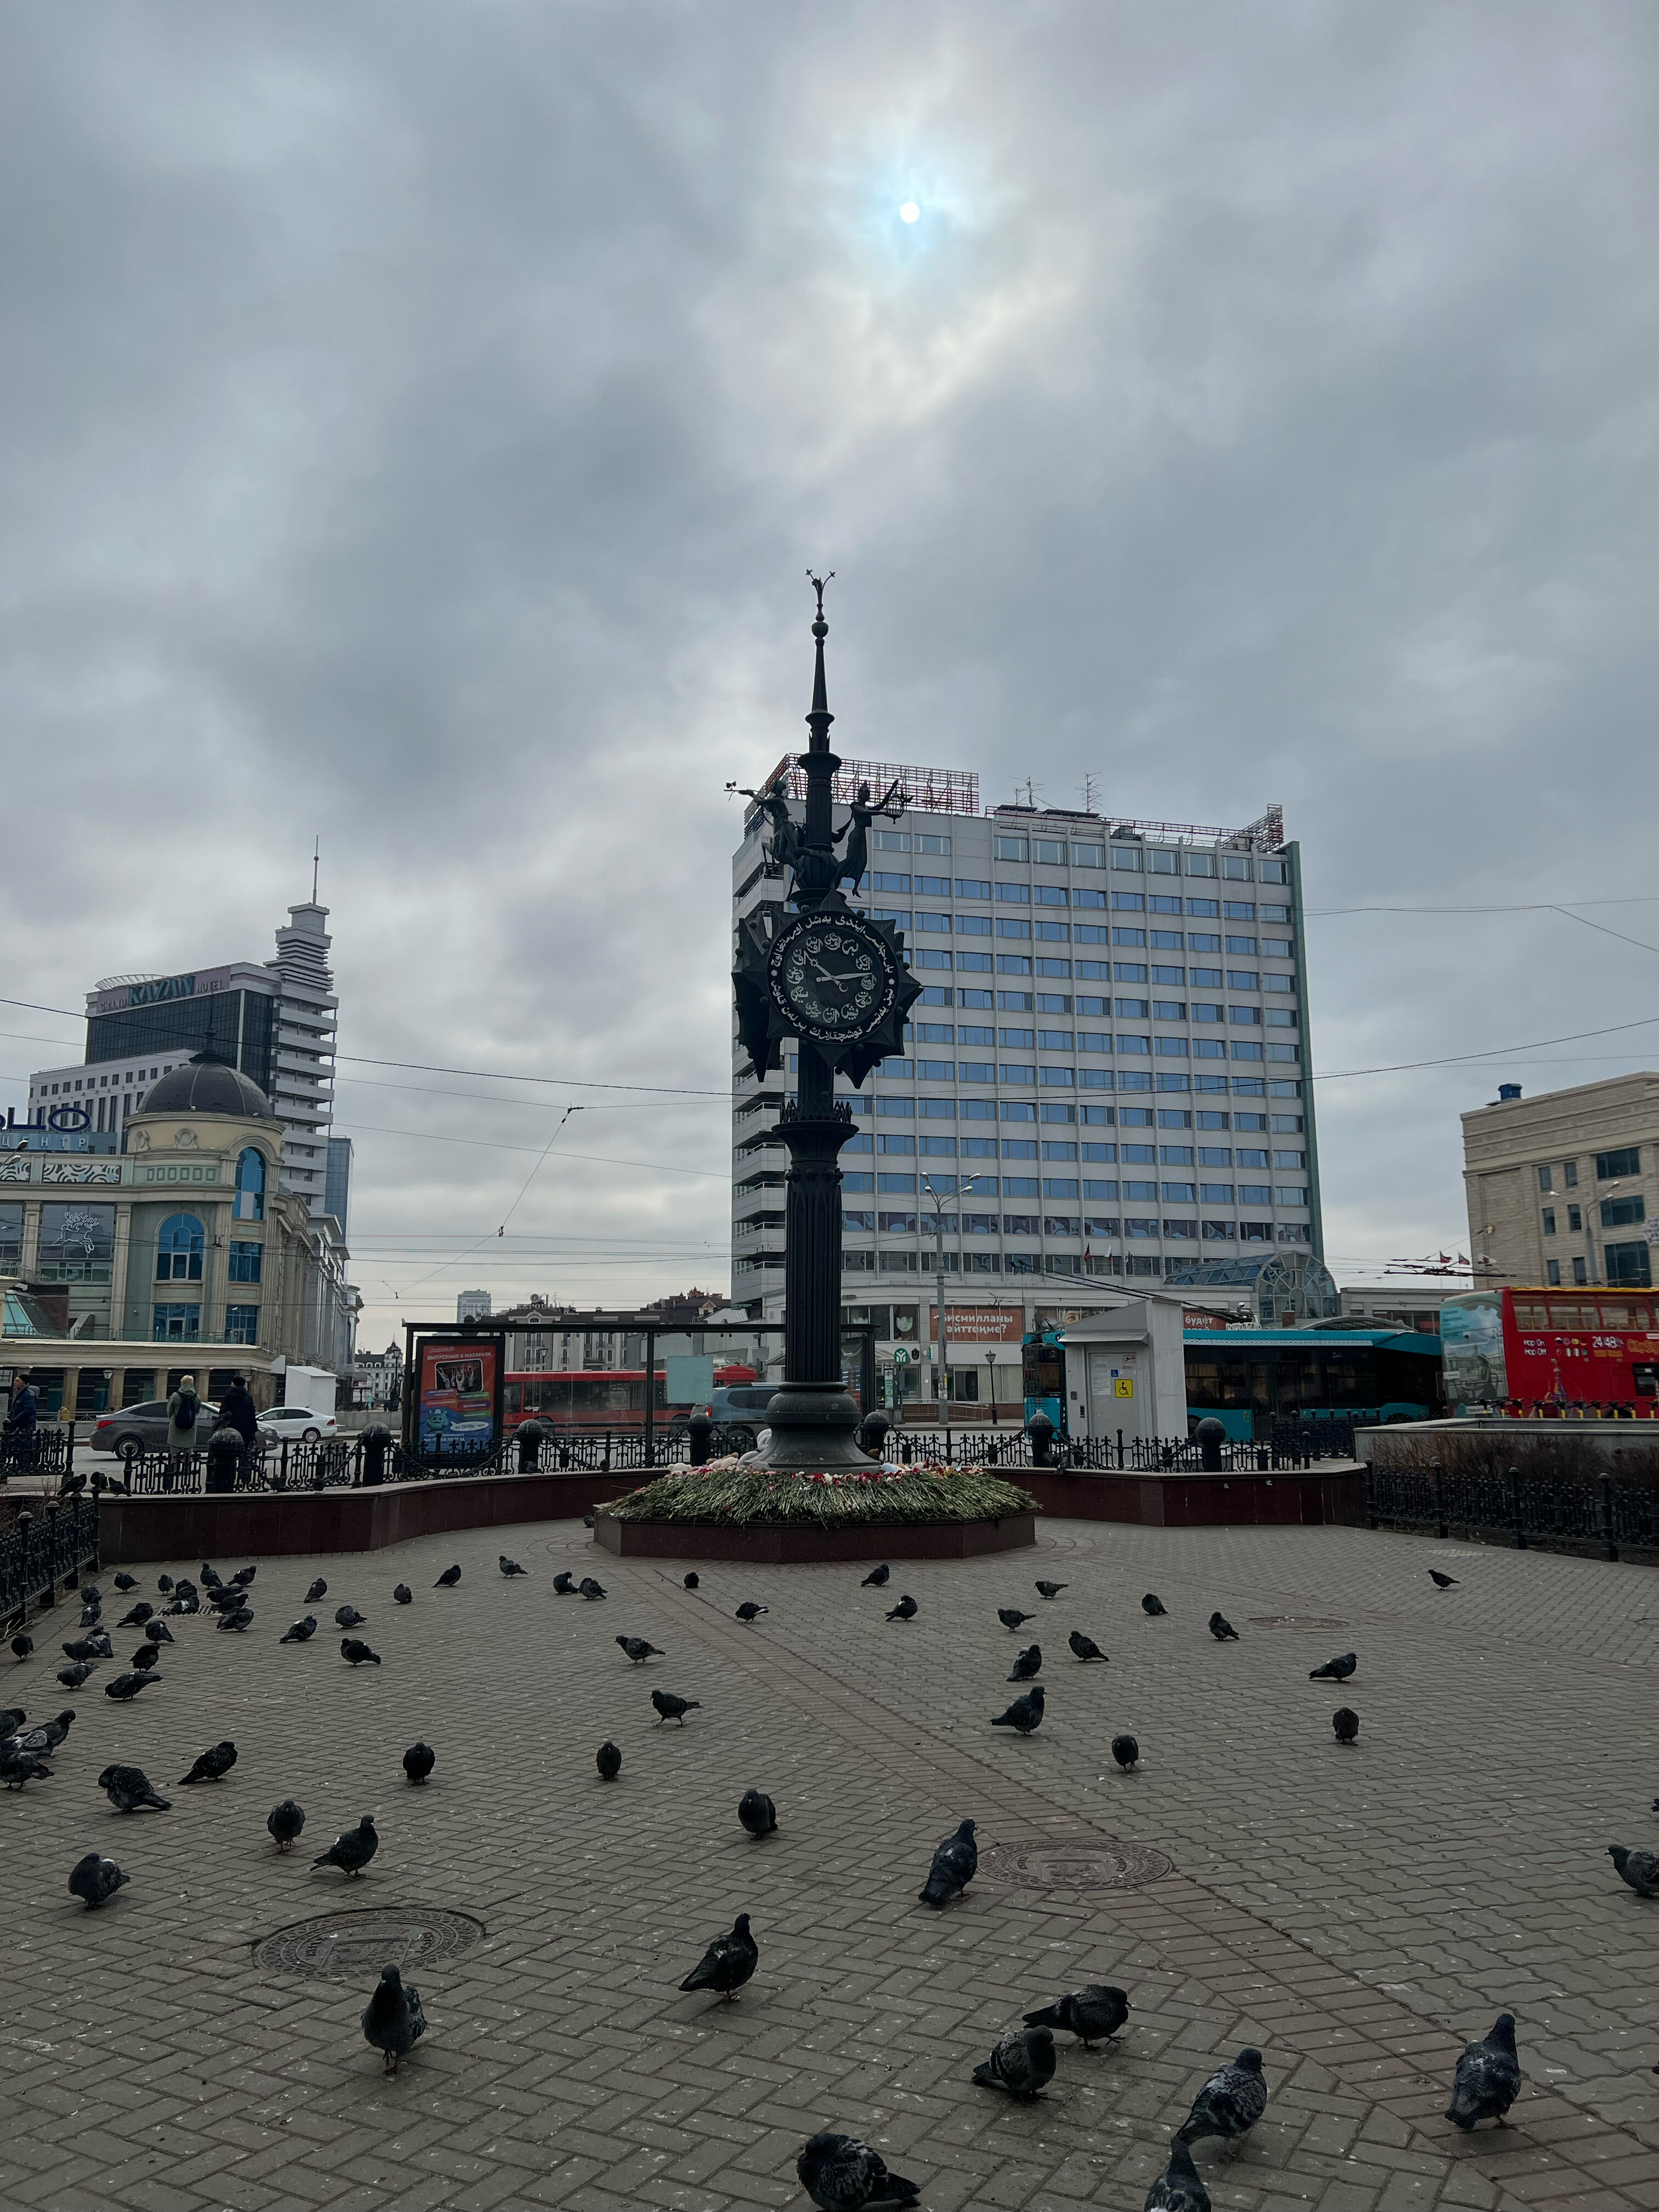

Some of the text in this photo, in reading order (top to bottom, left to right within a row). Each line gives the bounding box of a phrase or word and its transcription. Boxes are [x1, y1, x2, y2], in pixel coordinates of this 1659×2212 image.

[100, 975, 223, 1012] GRAND KAZAN HOTEL
[1185, 1315, 1214, 1326] будет
